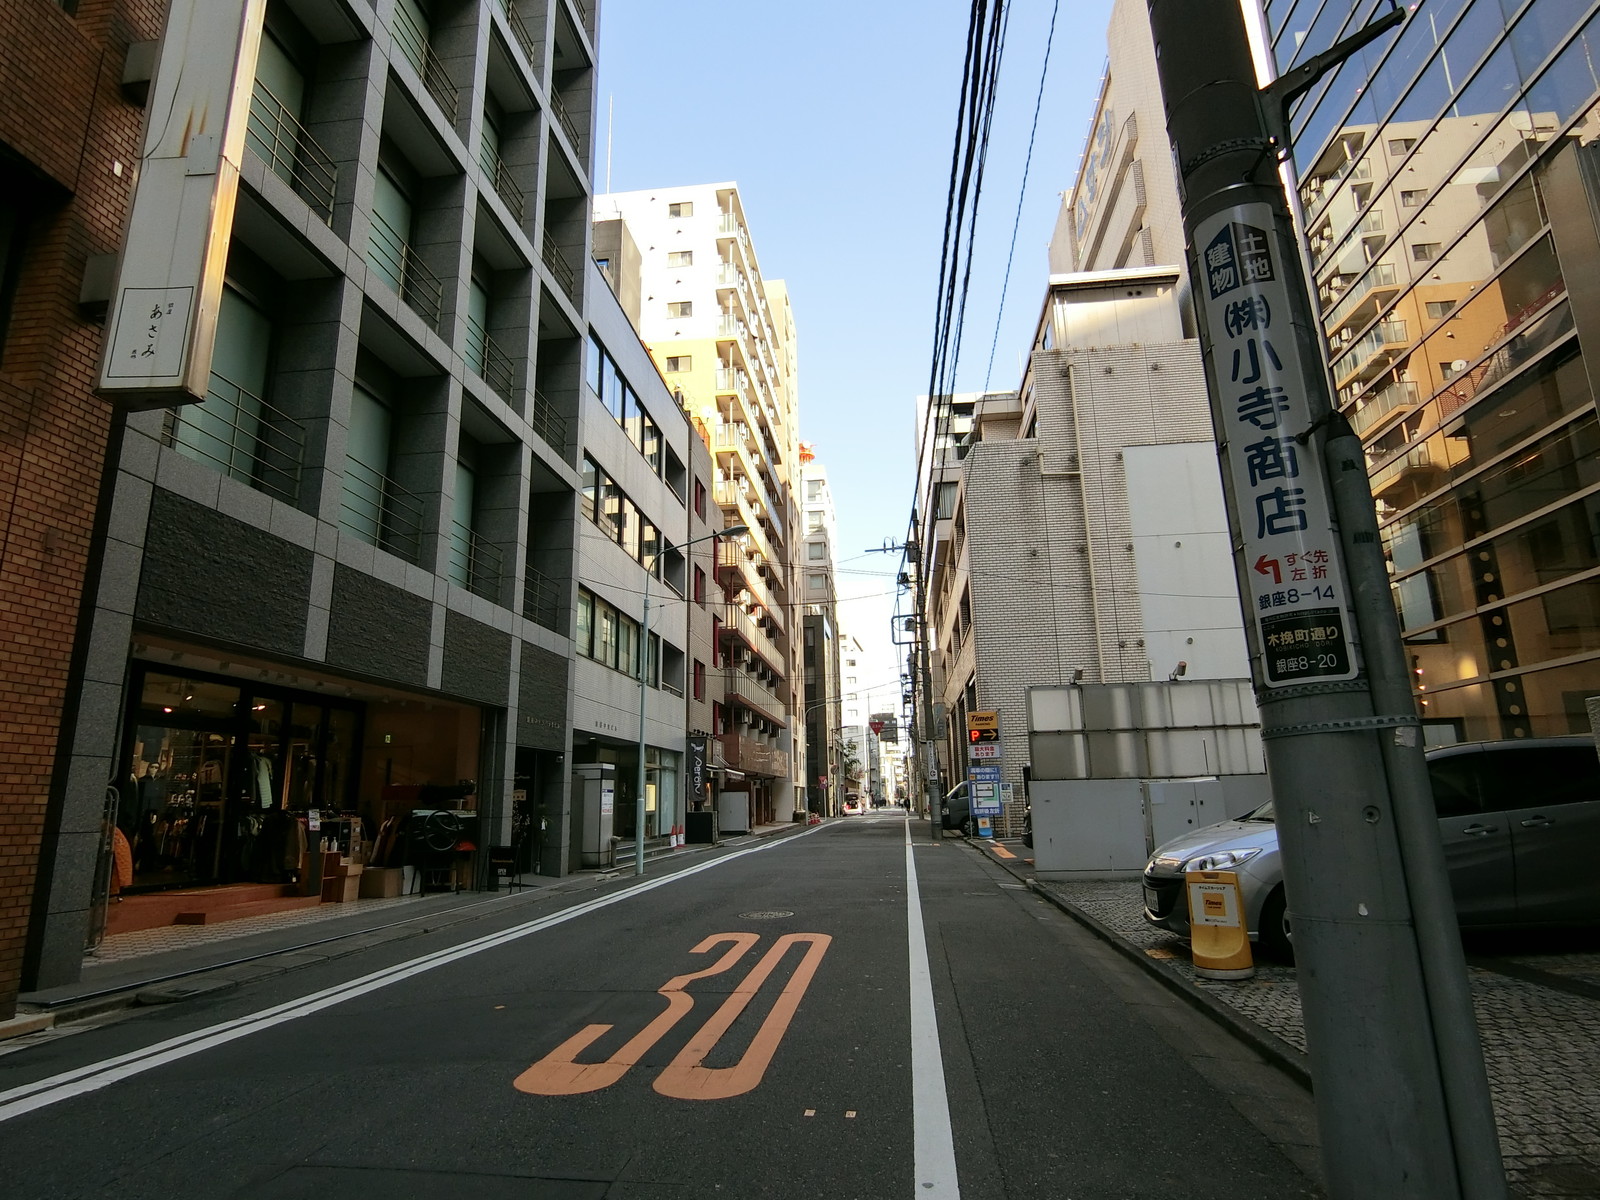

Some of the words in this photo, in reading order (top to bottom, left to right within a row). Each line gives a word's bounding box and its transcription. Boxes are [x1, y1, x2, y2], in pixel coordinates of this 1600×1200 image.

[1206, 242, 1236, 293] 建物
[1240, 233, 1271, 281] 土地
[141, 303, 163, 358] あさみ
[1284, 549, 1328, 567] すぐ先
[1267, 626, 1338, 647] 木挽町通り
[1315, 640, 1333, 648] DORI
[1276, 653, 1337, 674] 銀座8-20
[971, 730, 980, 742] P
[513, 932, 833, 1100] 30
